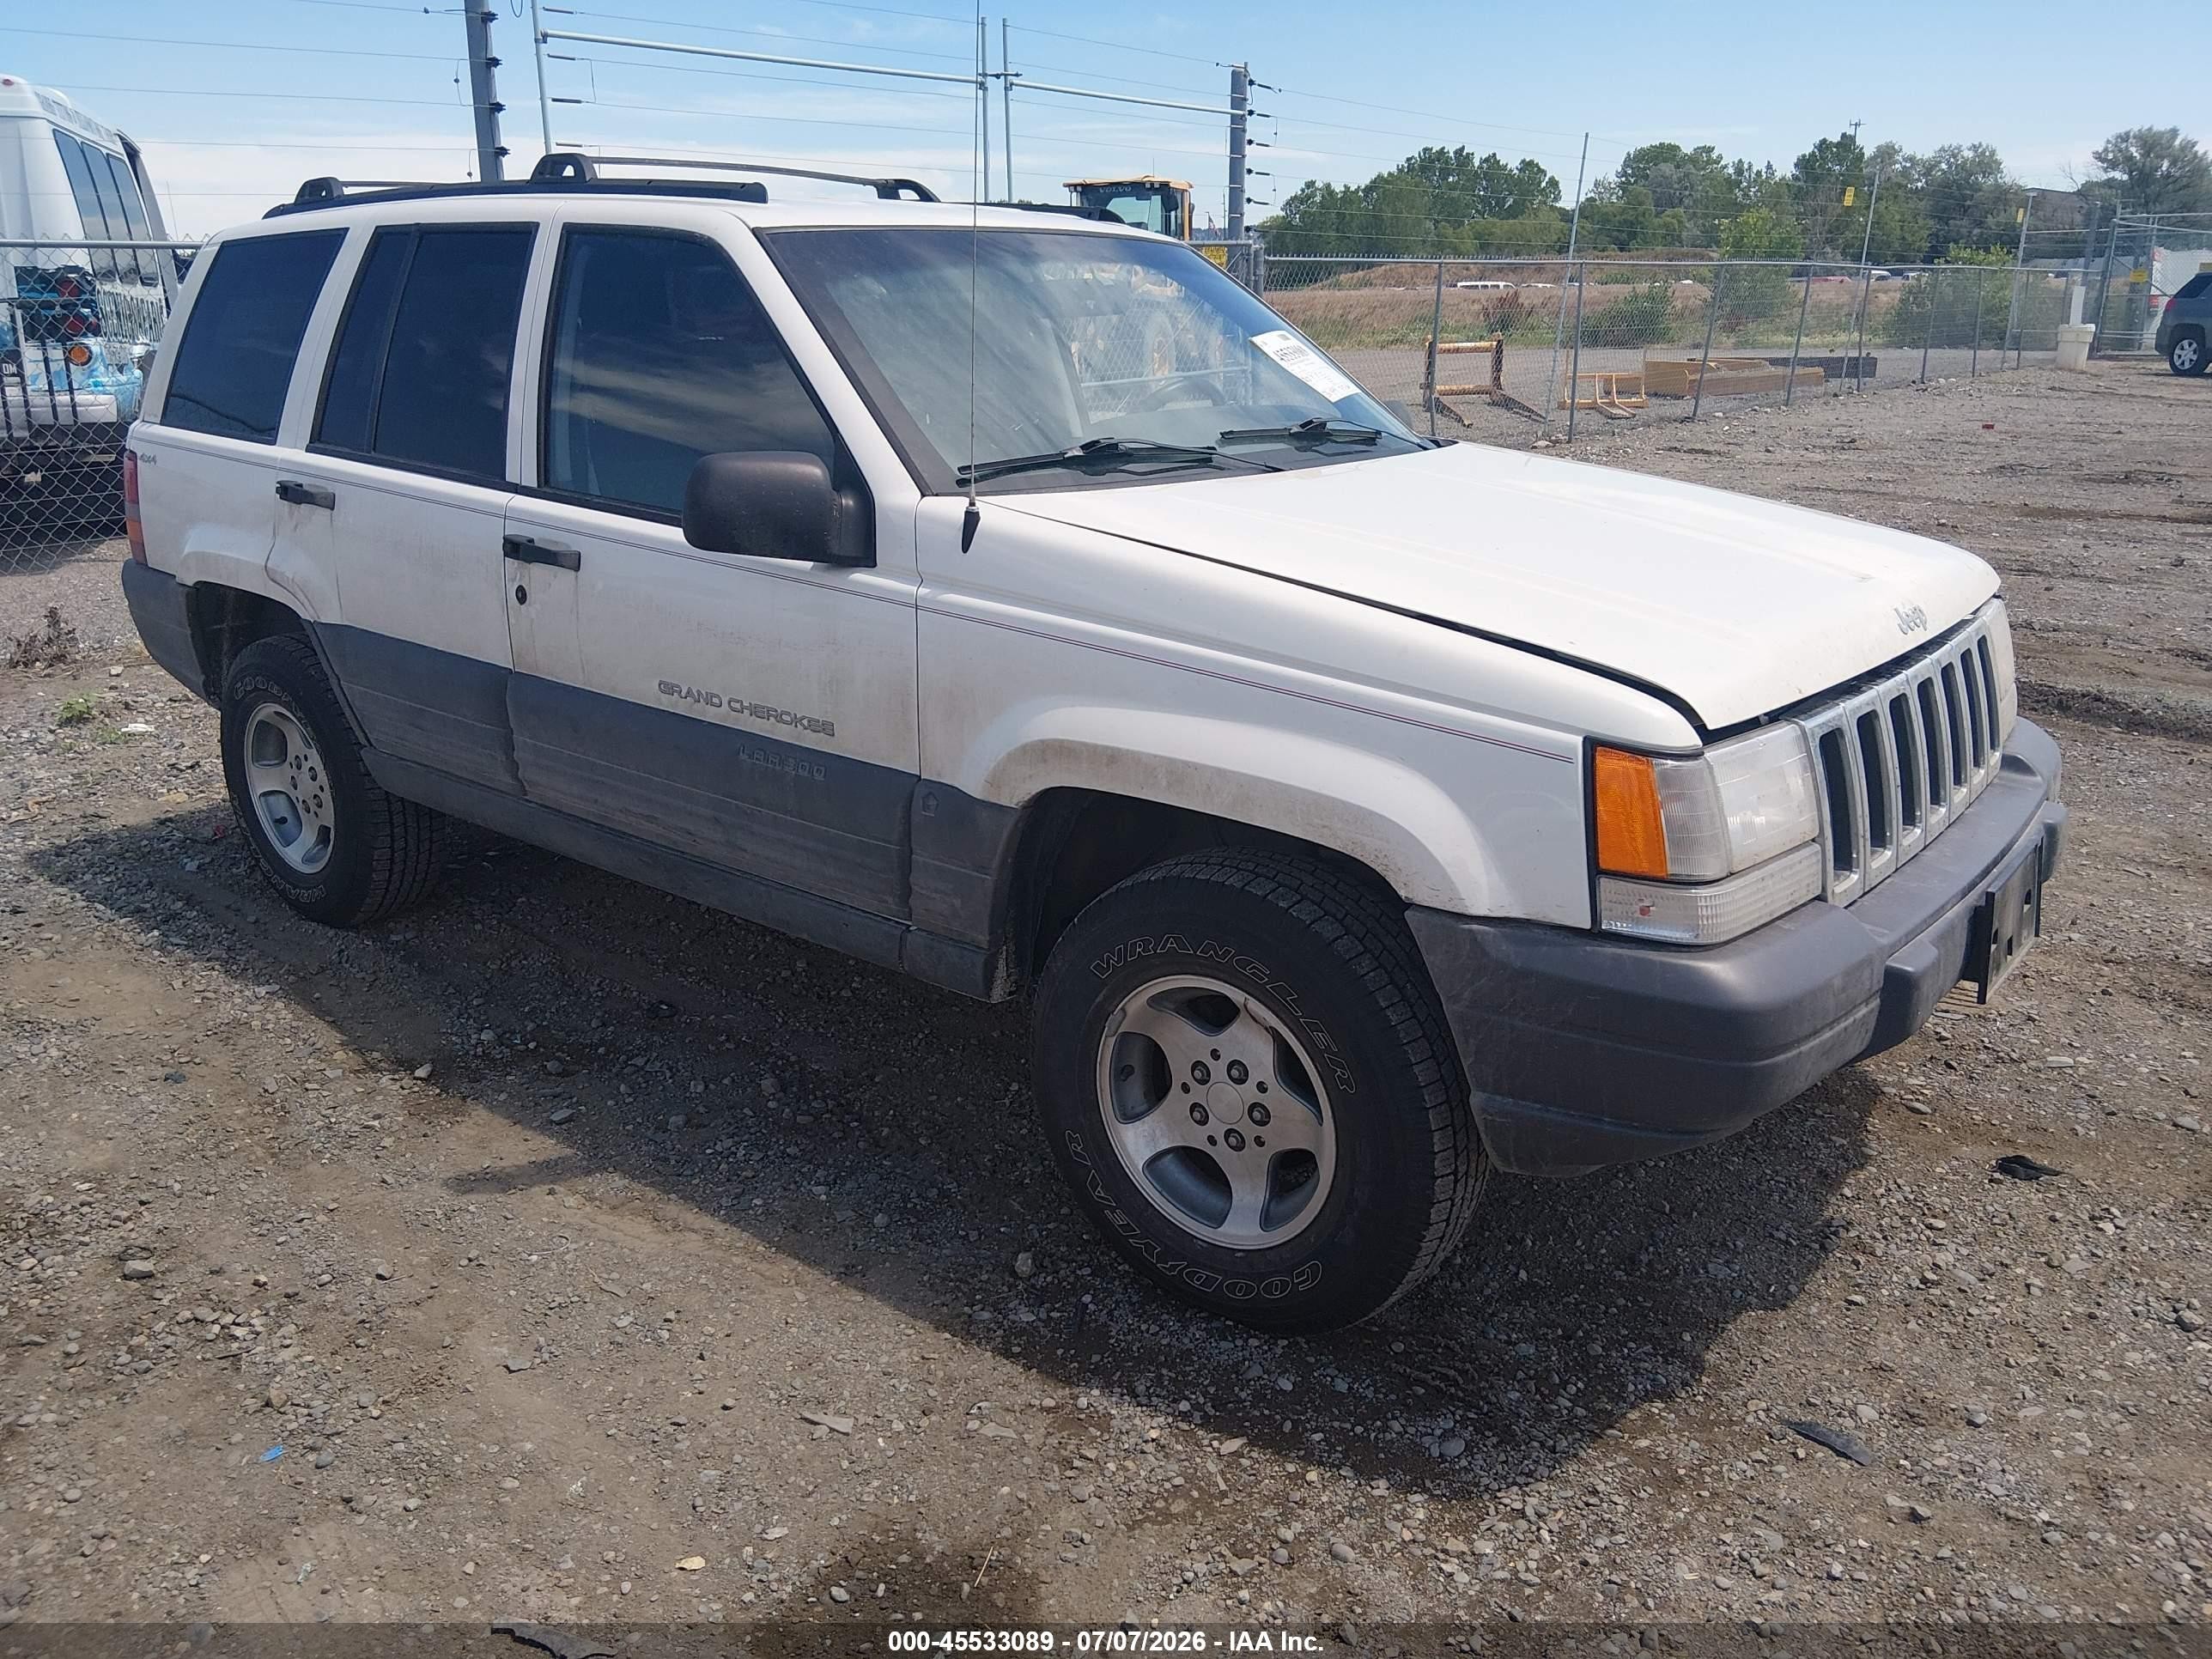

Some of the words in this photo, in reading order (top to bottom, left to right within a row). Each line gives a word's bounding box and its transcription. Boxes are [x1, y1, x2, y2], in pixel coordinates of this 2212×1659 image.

[1099, 185, 1133, 193] VOLVO
[1894, 605, 1928, 635] Jeep
[657, 679, 723, 708] GRAND
[727, 696, 836, 738] CHEROKEE
[1090, 933, 1356, 1095] WRANGLER
[1065, 1130, 1322, 1299] GOODYEAR
